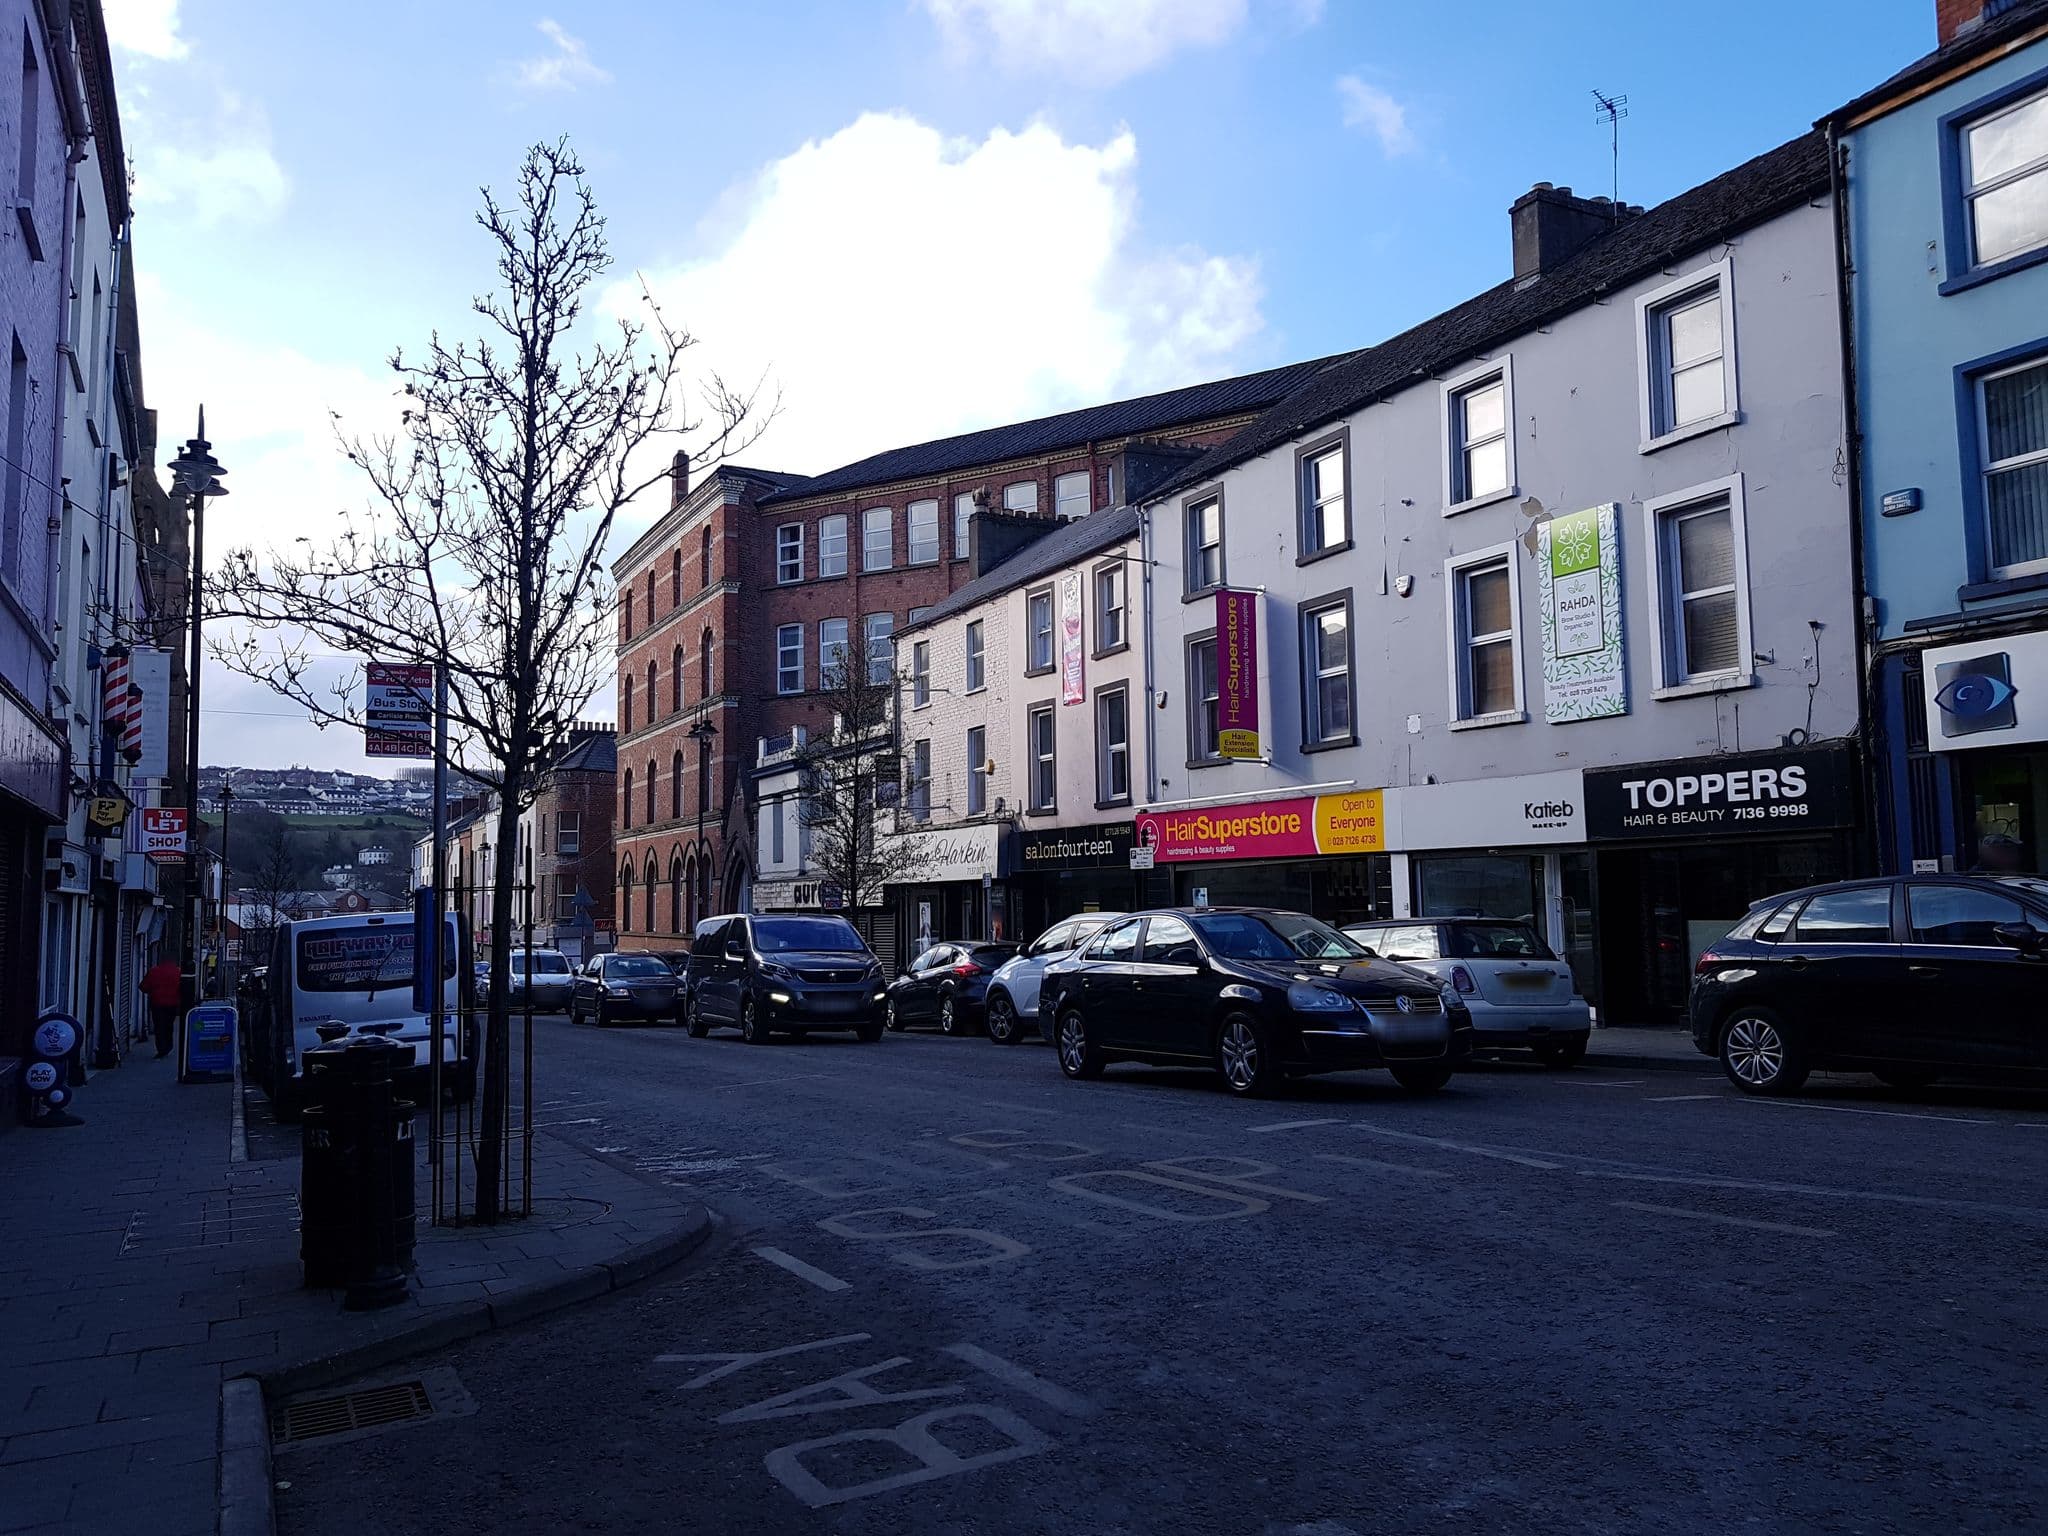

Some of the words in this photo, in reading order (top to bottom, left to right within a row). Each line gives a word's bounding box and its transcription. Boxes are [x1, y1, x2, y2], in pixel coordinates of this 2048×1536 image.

[1241, 598, 1250, 625] supplies
[1559, 595, 1596, 613] RAHDA
[1574, 613, 1591, 621] Studio
[1563, 623, 1583, 632] Organic
[1583, 620, 1594, 628] Spa
[1241, 627, 1250, 650] beauty
[1227, 596, 1241, 723] HairSuperstore
[1241, 657, 1250, 699] hairdressing
[374, 698, 396, 708] Bus
[399, 698, 428, 711] Stop
[1224, 739, 1255, 747] Extension
[1231, 732, 1246, 741] Hair
[367, 744, 381, 752] 4A
[384, 744, 398, 752] 4B
[400, 744, 414, 753] 4C
[418, 745, 431, 753] 5A
[1223, 745, 1256, 754] Specialists
[1621, 765, 1808, 810] TOPPERS
[1341, 799, 1364, 811] Open
[1366, 798, 1375, 809] to
[1524, 800, 1574, 819] Katieb
[158, 810, 173, 818] TO
[1330, 814, 1376, 830] Everyone
[1623, 814, 1654, 827] HAIR
[1657, 812, 1668, 825] &
[1671, 809, 1725, 824] BEAUTY
[1733, 806, 1765, 820] 7136
[1769, 804, 1809, 818] 9998
[147, 817, 183, 831] LET
[1165, 811, 1301, 844] HairSuperstore
[148, 837, 182, 847] SHOP
[935, 830, 986, 867] Harkin
[1025, 838, 1114, 860] salonfourteen
[1166, 847, 1194, 856] hairdressing
[1215, 844, 1236, 854] supplies
[653, 1332, 1048, 1509] BAY
